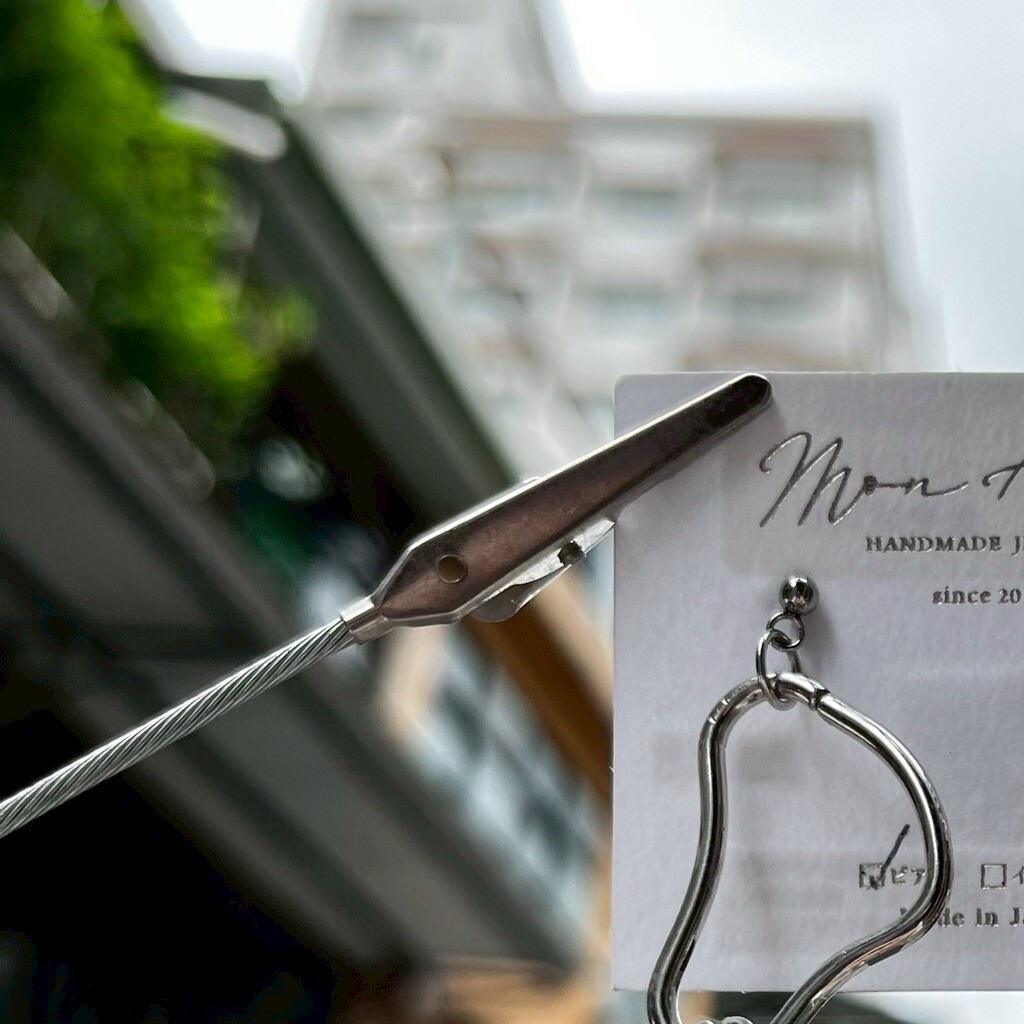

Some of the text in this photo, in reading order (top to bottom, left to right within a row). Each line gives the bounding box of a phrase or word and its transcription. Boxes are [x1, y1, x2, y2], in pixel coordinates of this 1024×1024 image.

[759, 431, 969, 527] Mon
[865, 535, 1002, 553] HANDMADE
[932, 586, 991, 605] since
[890, 865, 926, 885] ピア
[976, 907, 999, 927] in
